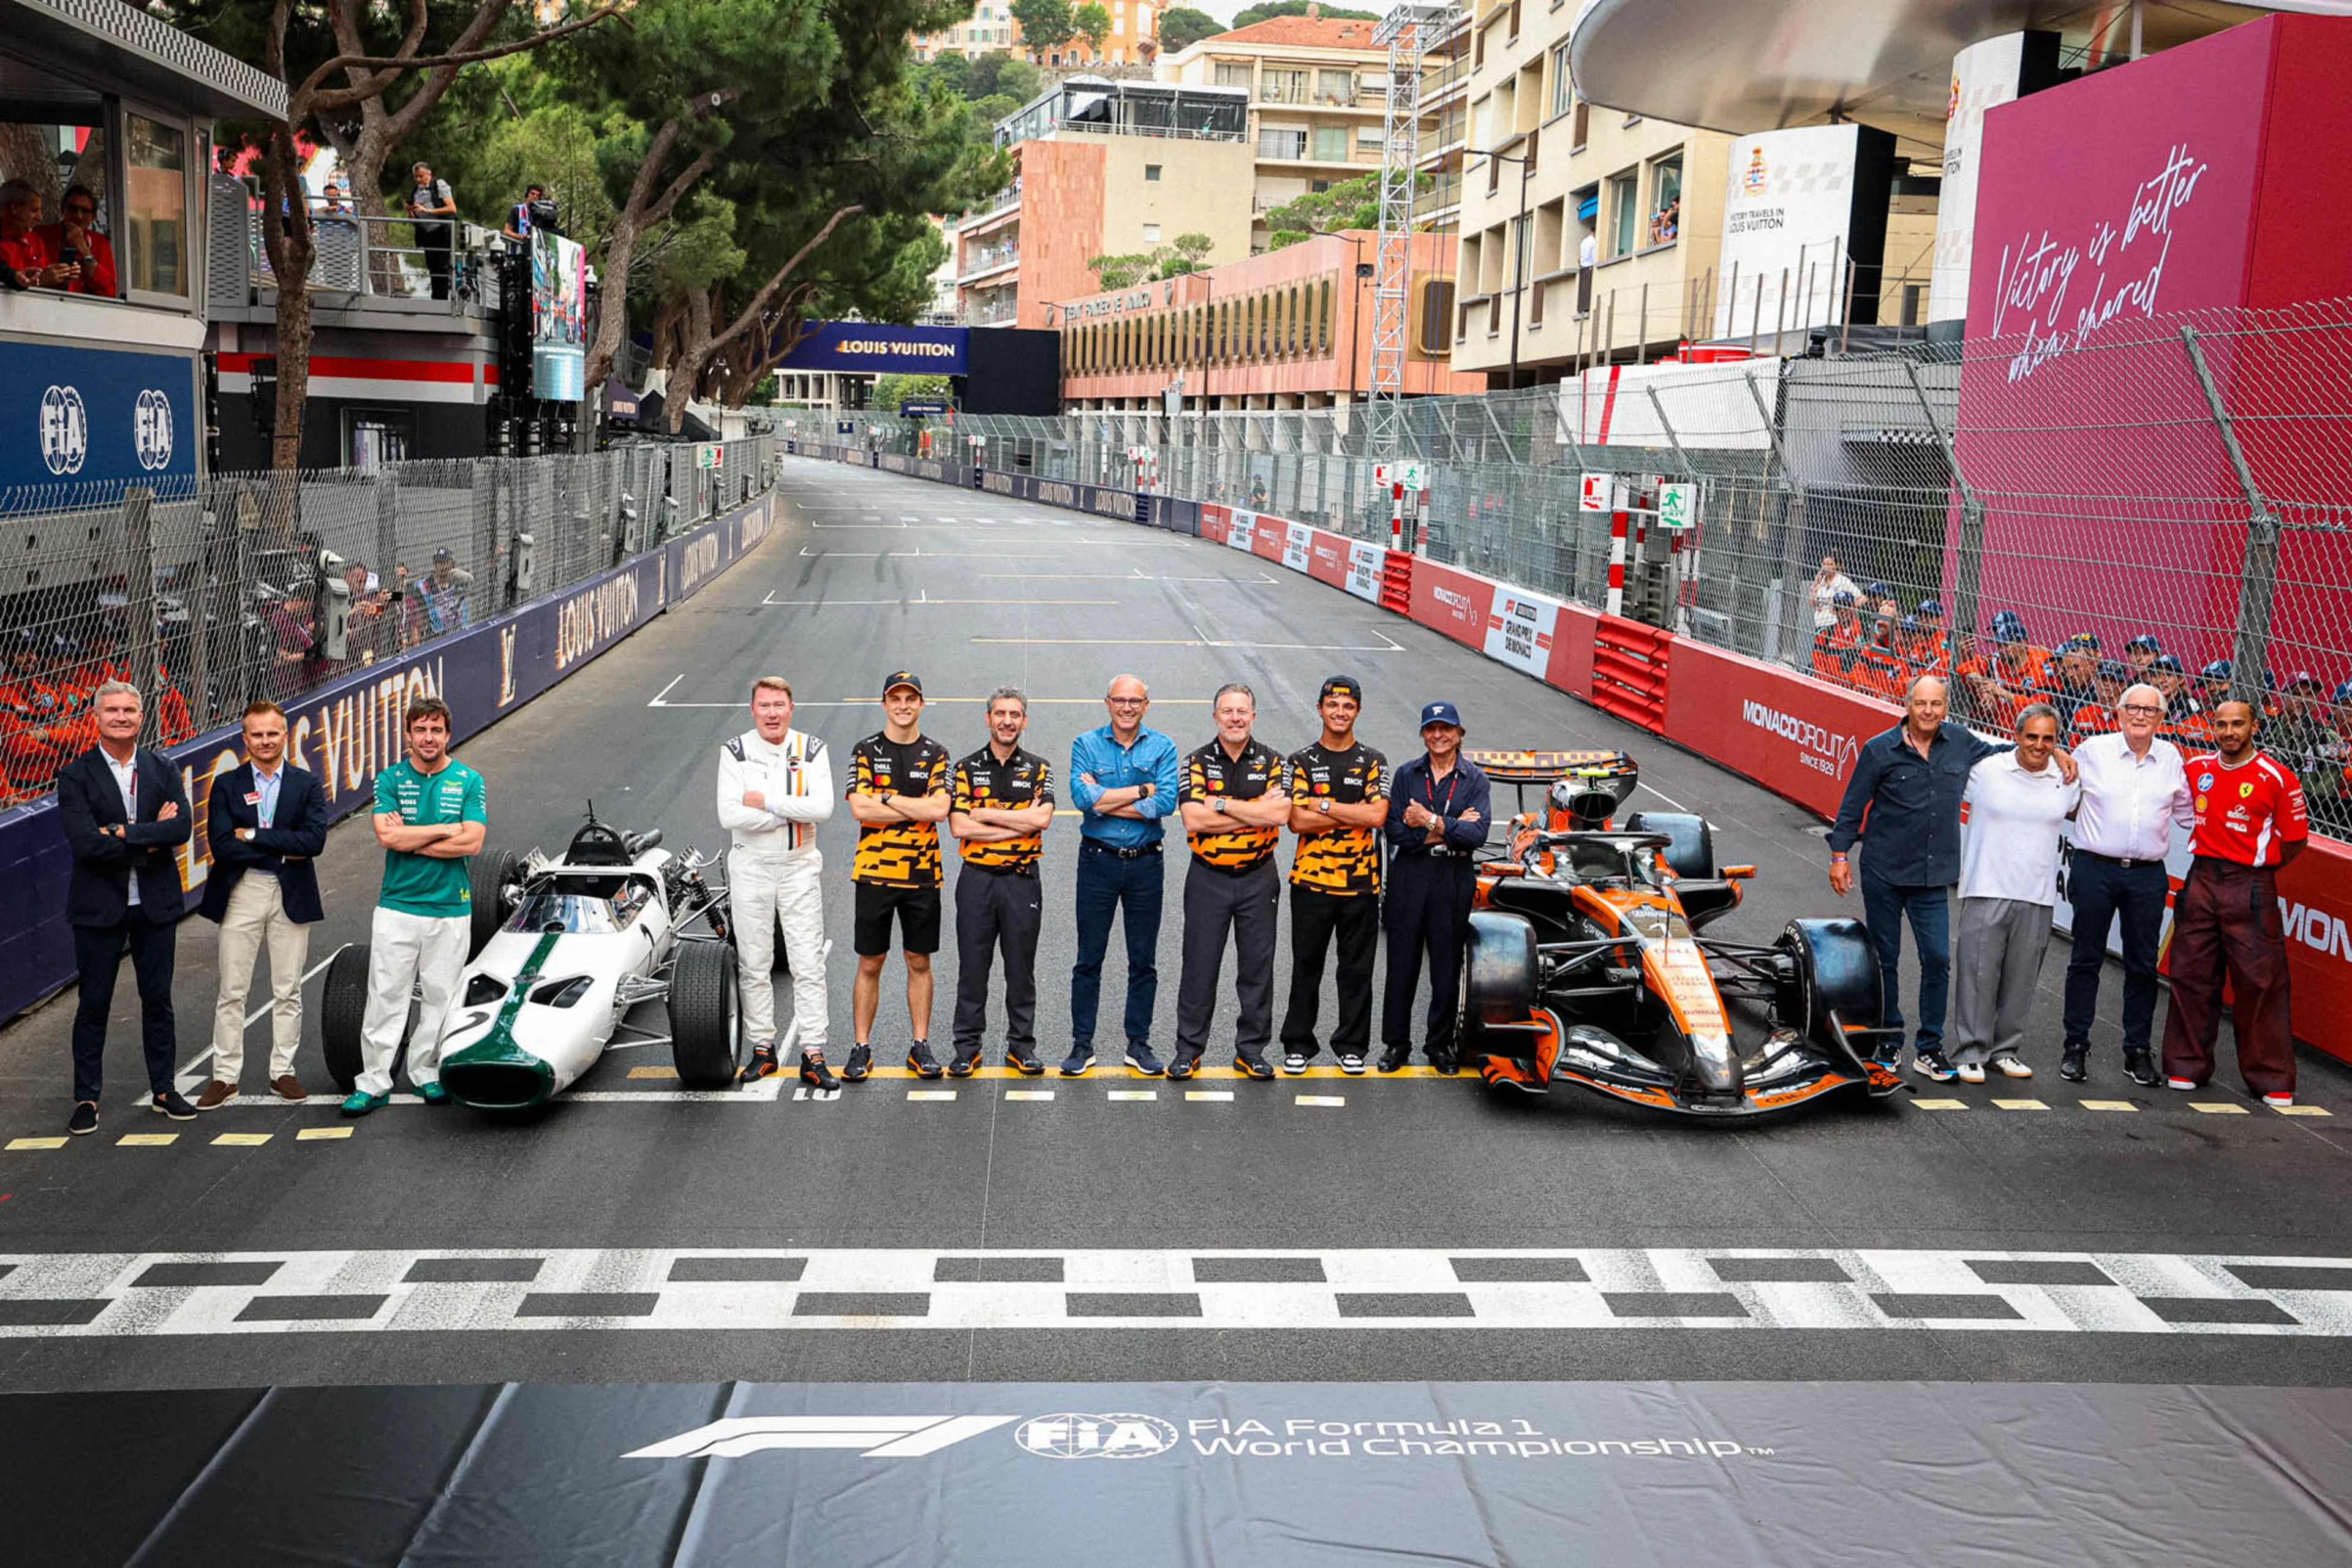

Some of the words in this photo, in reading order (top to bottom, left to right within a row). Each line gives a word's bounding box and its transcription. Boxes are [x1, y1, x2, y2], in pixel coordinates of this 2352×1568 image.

[1729, 221, 1746, 233] LOUIS
[1746, 217, 1784, 232] VUITTON
[1749, 208, 1774, 219] TRAVELS
[1992, 230, 2079, 339] Victory
[2089, 221, 2116, 266] is
[2120, 143, 2207, 252] better
[2075, 230, 2173, 351] shared
[842, 339, 888, 355] LOUIS
[889, 342, 956, 357] VUITTON
[1095, 489, 1113, 511] LOUIS
[1112, 492, 1135, 517] VUITTON
[556, 590, 595, 669] LOUIS
[596, 567, 639, 642] VUITTON
[1800, 752, 1819, 769] SINCE
[1819, 758, 1835, 777] 1929
[1187, 1419, 1275, 1436] FIA
[1285, 1418, 1502, 1436] Formula
[1511, 1418, 1545, 1435] 1
[1191, 1437, 1352, 1457] World
[1363, 1437, 1744, 1458] Championship
